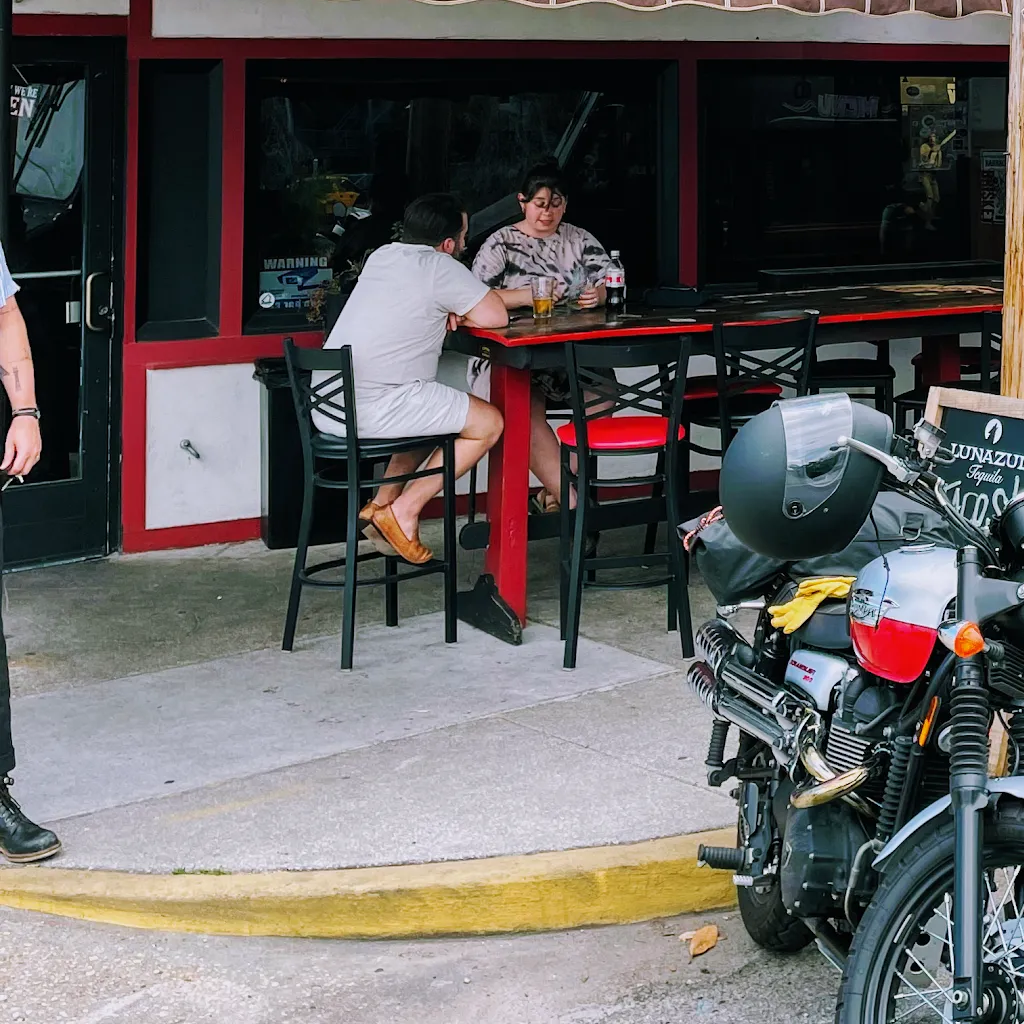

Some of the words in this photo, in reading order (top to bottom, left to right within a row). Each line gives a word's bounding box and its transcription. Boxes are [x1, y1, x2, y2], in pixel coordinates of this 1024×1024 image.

[10, 96, 36, 118] EN
[263, 256, 328, 269] WARNING
[966, 464, 1003, 486] Tequila
